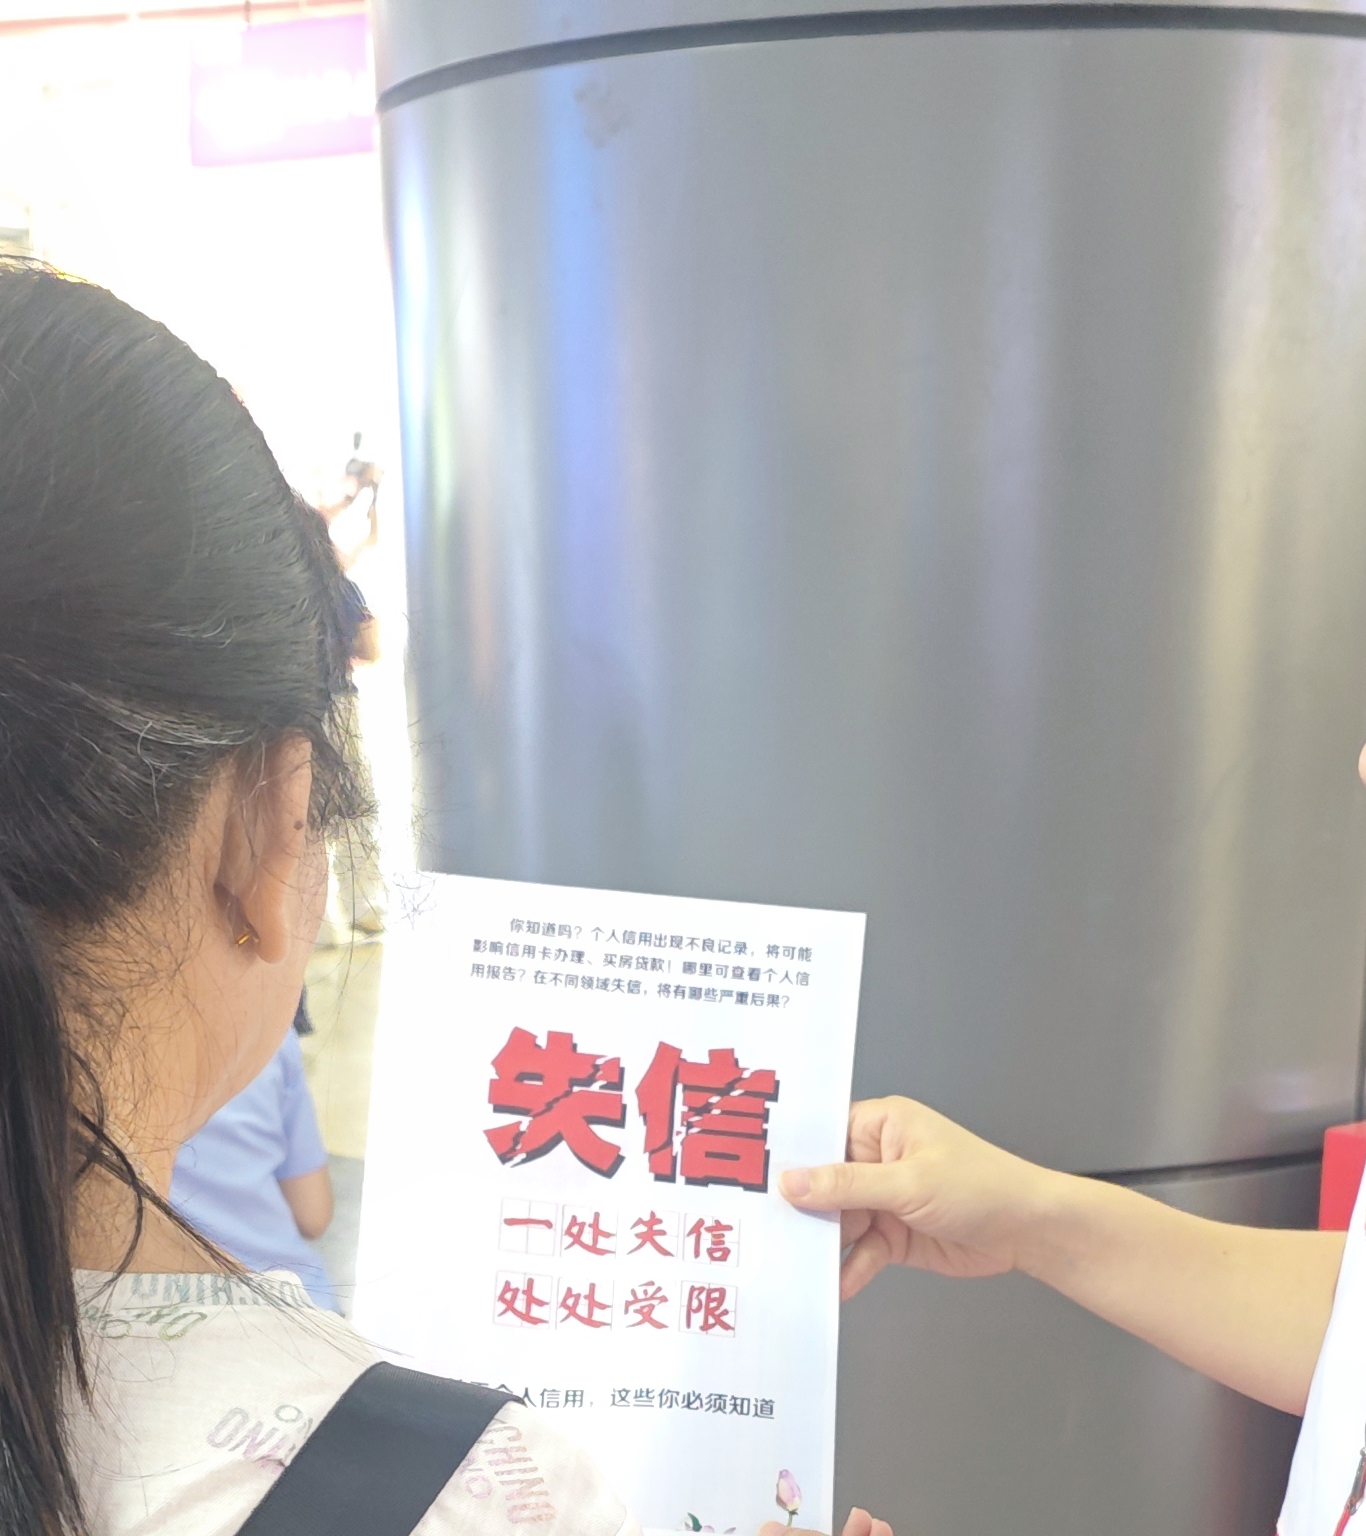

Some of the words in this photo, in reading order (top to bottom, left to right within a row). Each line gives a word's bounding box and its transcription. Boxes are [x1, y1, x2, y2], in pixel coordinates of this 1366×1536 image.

[483, 1026, 780, 1193] 失信
[503, 1210, 734, 1262] 一处失信
[497, 1278, 735, 1331] 处处受限
